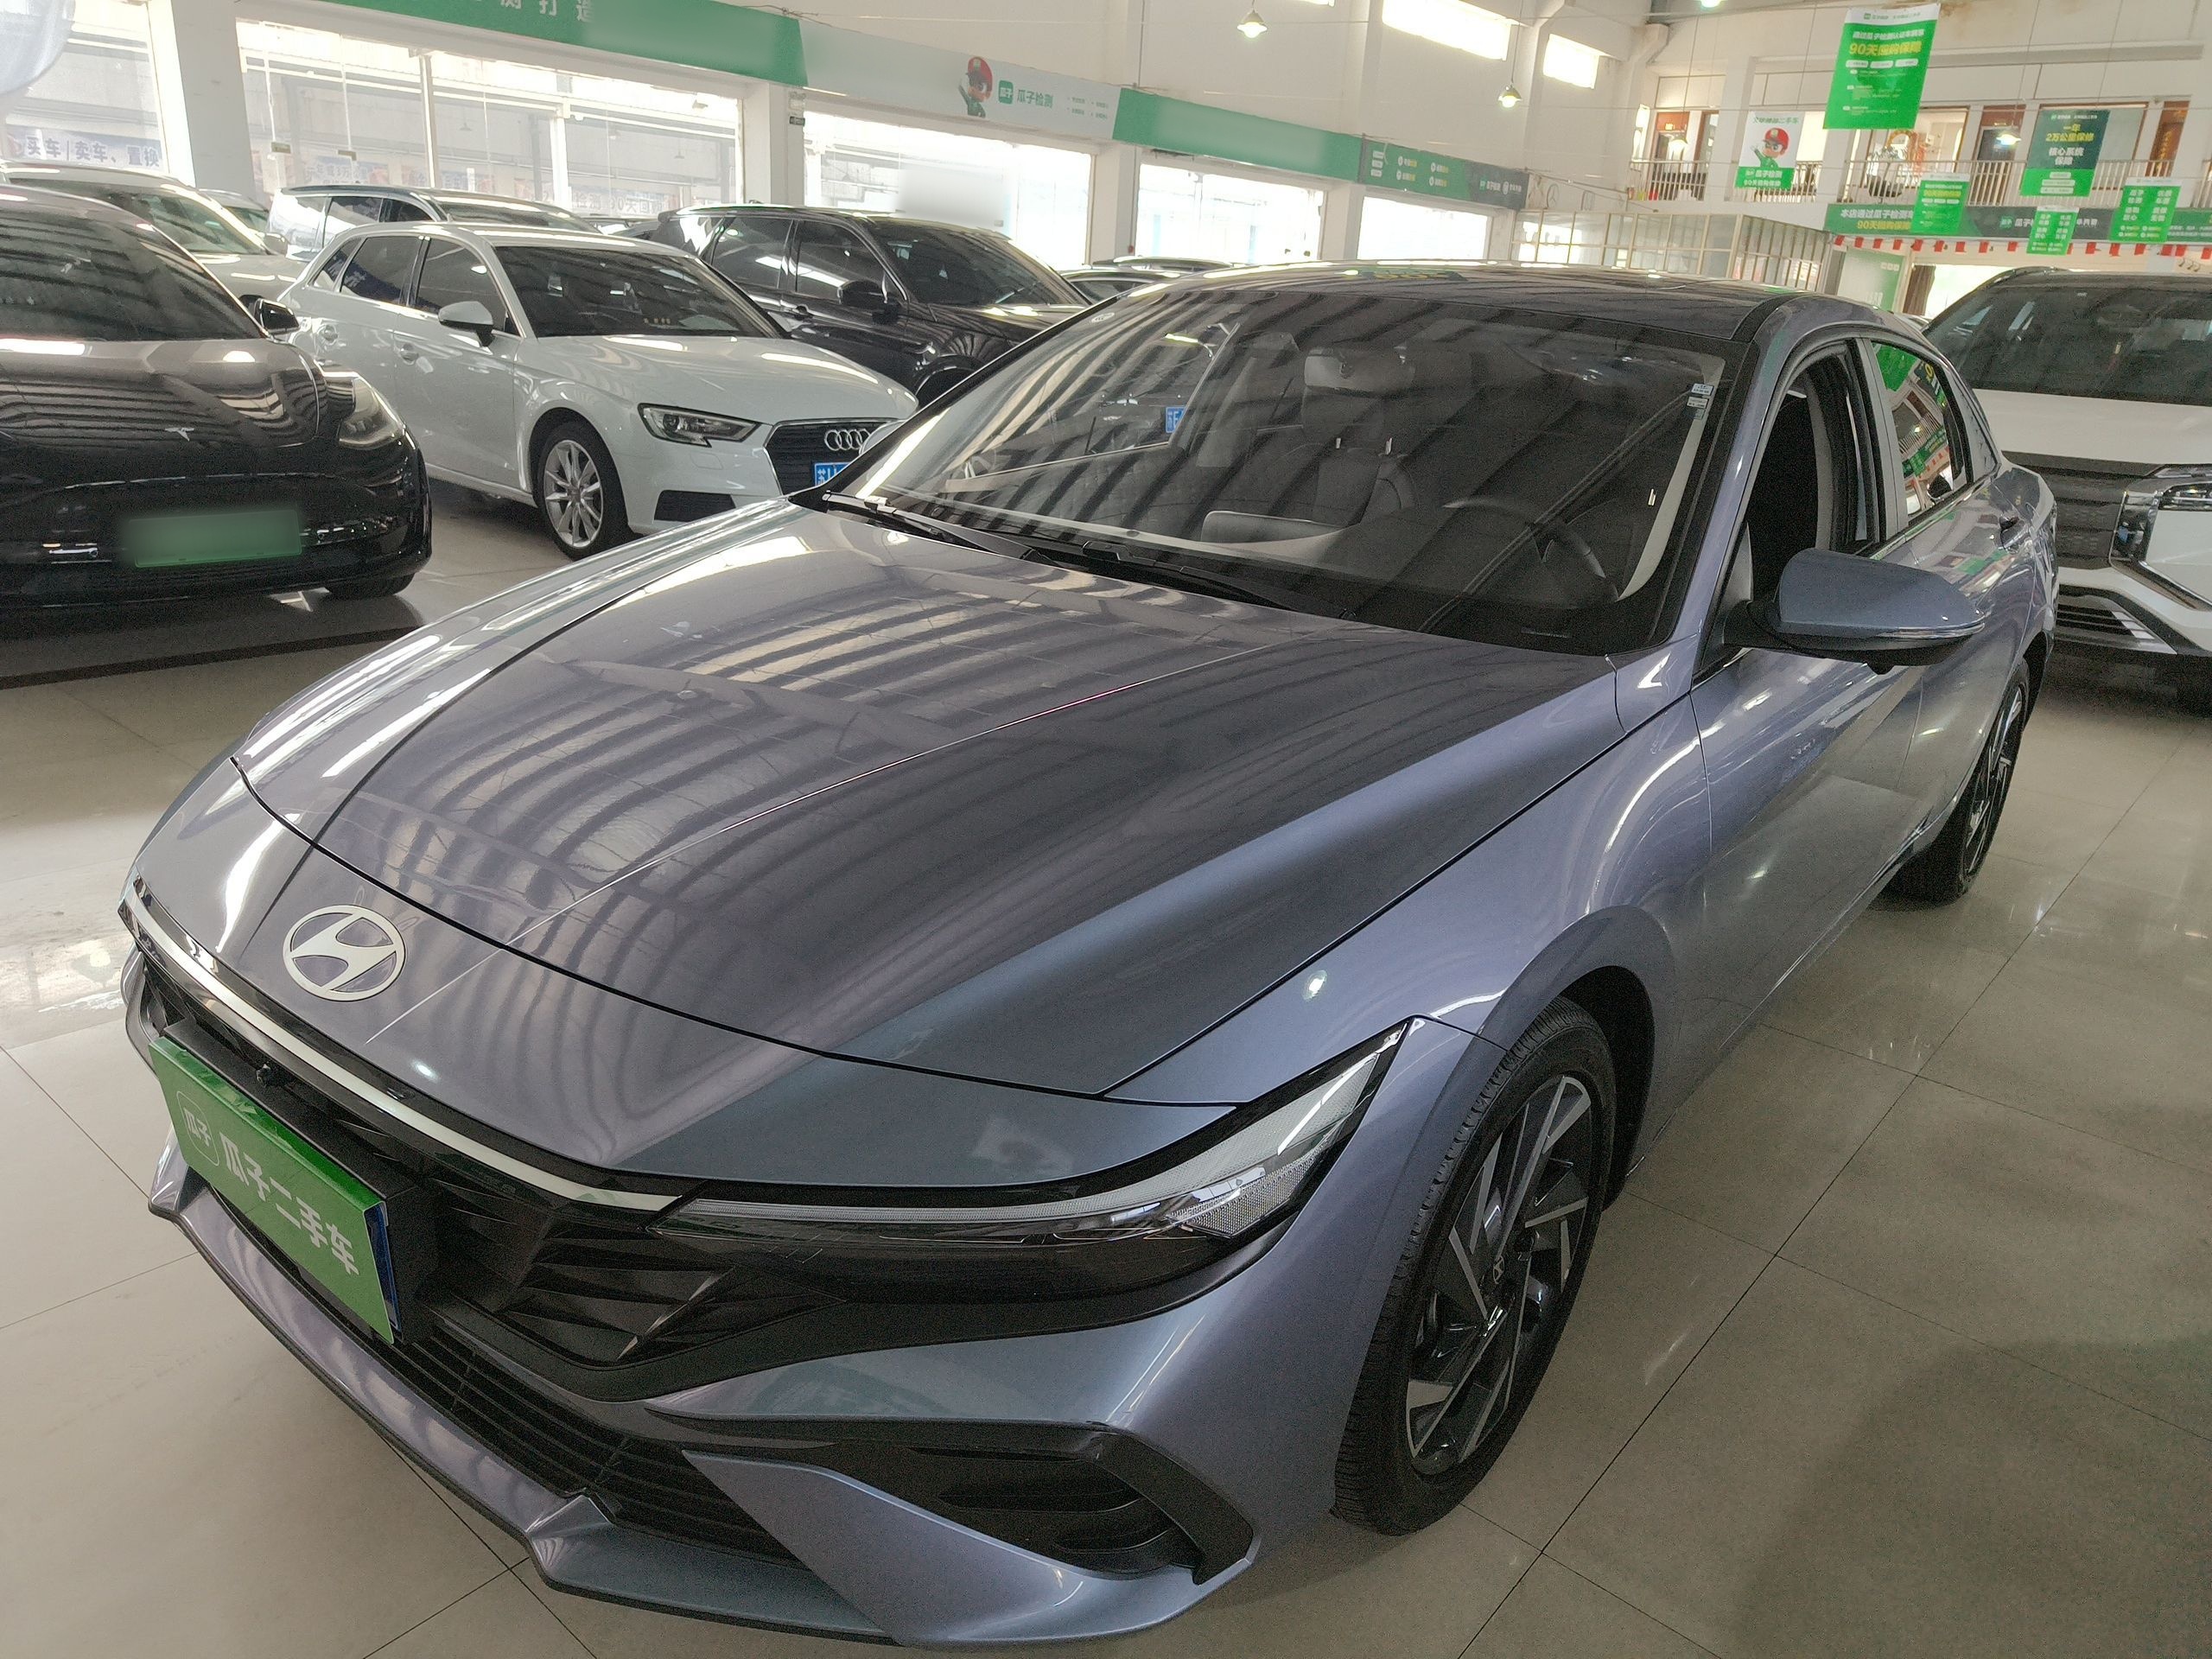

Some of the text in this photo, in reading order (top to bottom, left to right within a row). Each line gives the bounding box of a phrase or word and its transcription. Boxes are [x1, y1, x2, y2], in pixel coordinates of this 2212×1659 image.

[1017, 89, 1054, 108] 瓜子检测
[183, 1109, 212, 1147] 瓜子
[219, 1131, 360, 1276] 瓜子二手车
